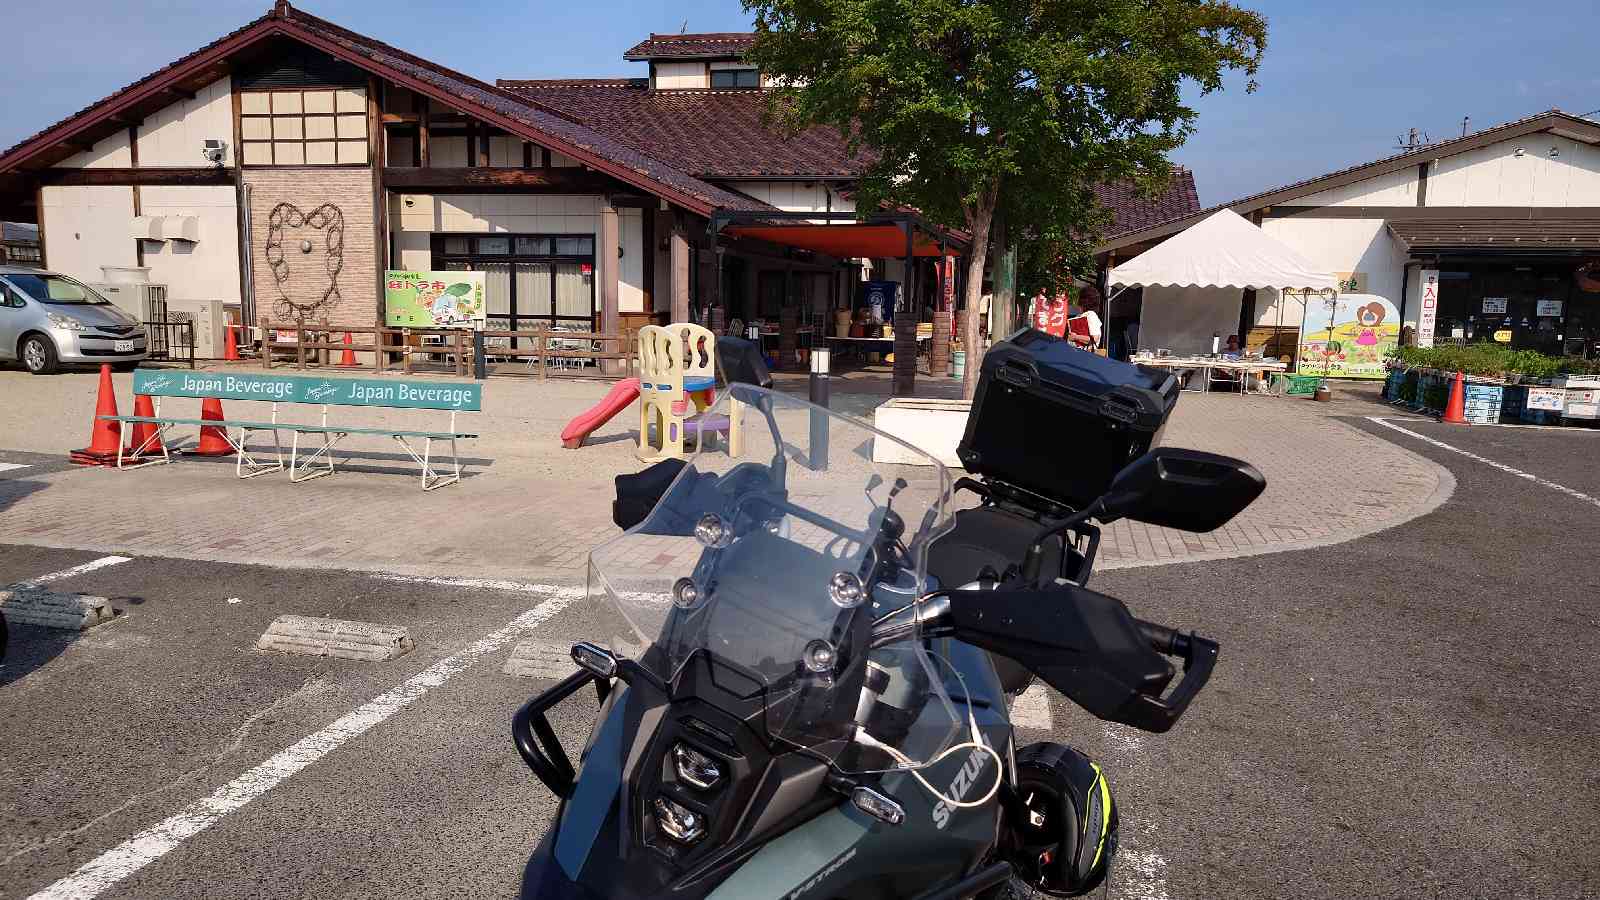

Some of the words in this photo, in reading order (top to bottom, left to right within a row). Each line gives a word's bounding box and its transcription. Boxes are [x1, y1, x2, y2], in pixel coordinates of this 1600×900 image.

[180, 375, 222, 394] Japan
[226, 376, 293, 398] Beverage
[348, 382, 394, 402] Japan
[398, 383, 472, 407] Beverage
